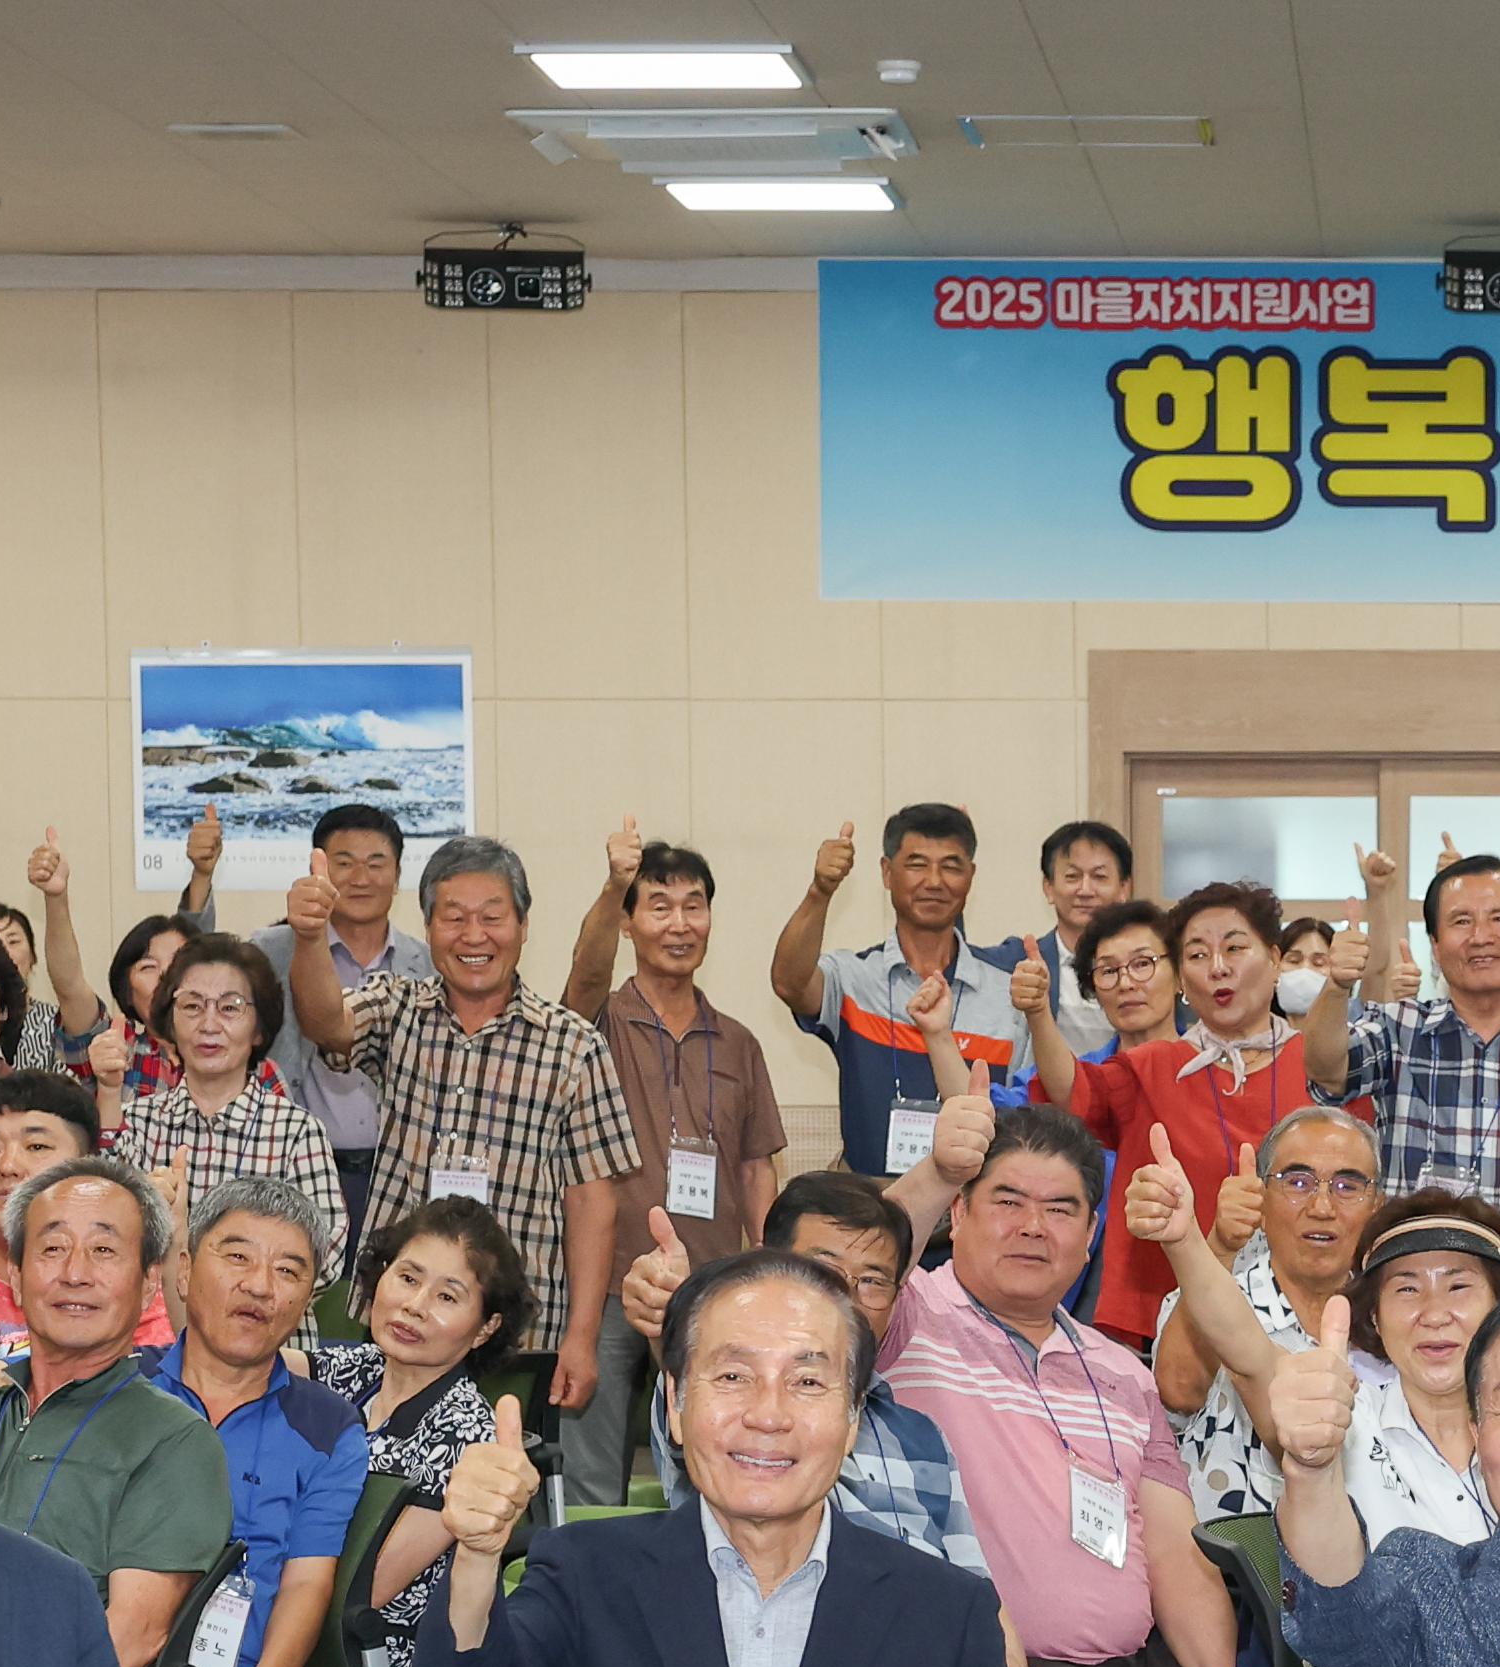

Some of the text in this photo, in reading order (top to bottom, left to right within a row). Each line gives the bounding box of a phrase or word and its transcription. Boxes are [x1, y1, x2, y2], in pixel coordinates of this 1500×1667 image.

[939, 280, 1371, 324] 2025 마을자치지원사업
[143, 855, 163, 870] 08
